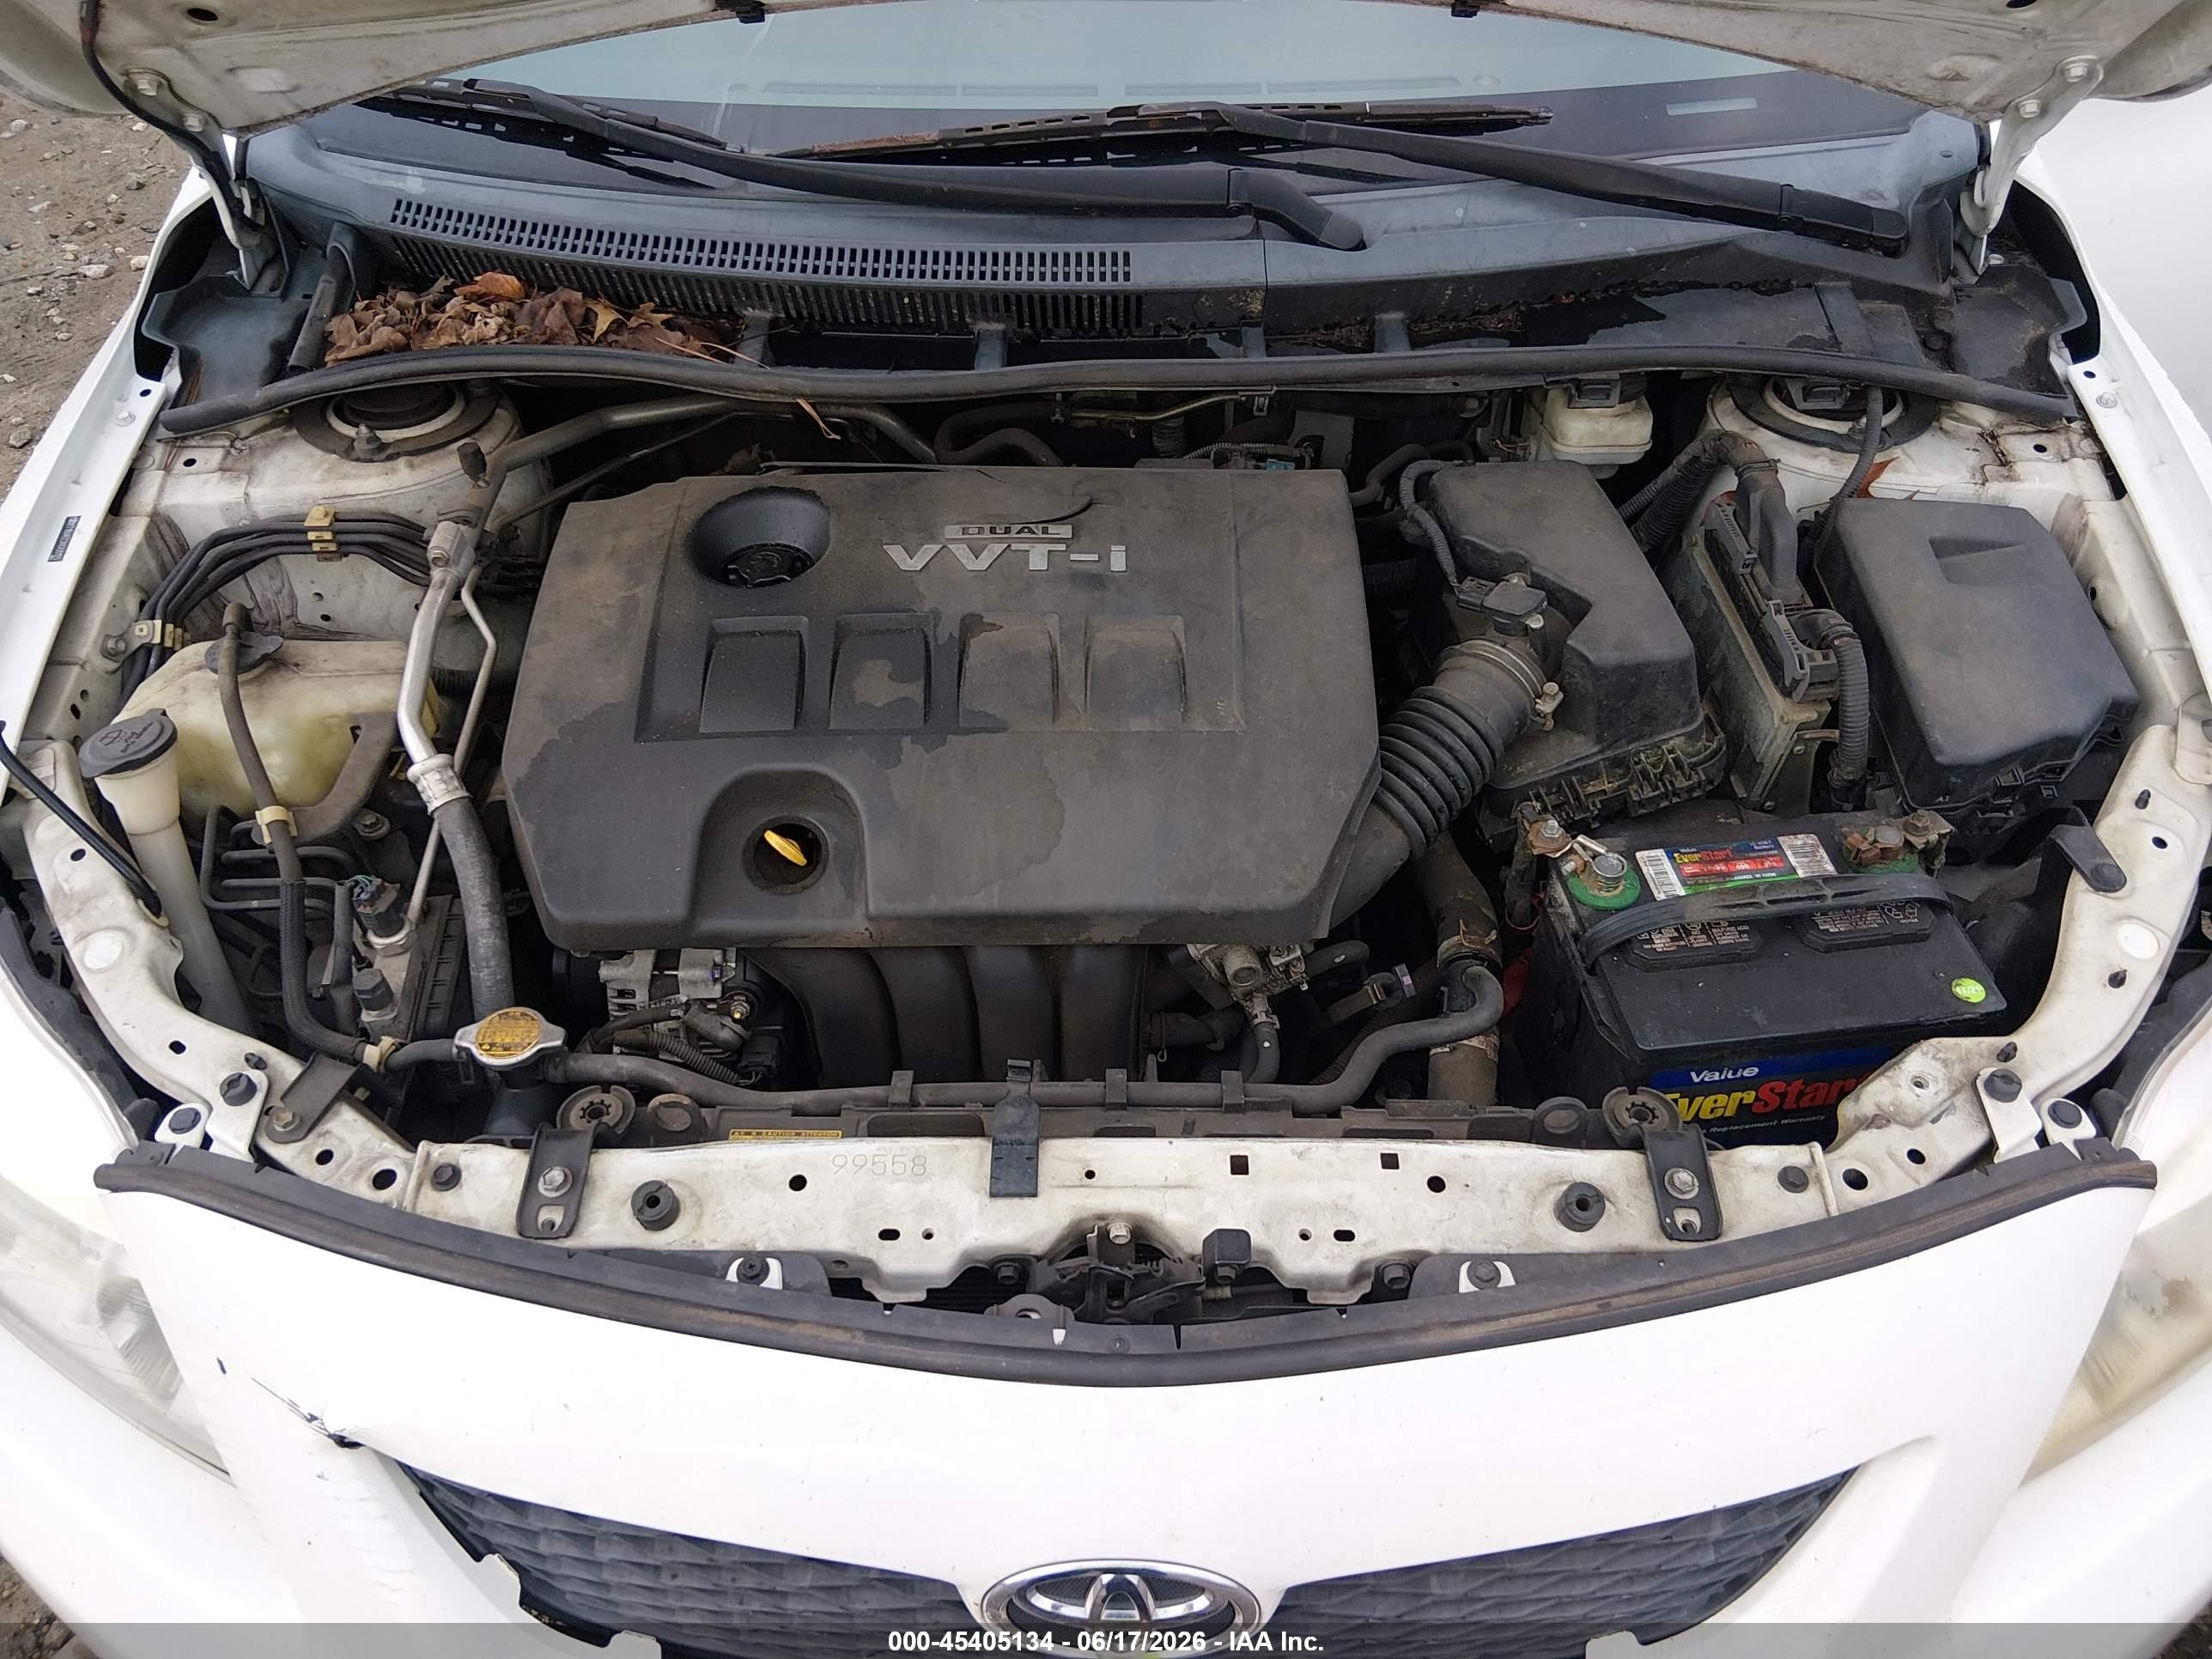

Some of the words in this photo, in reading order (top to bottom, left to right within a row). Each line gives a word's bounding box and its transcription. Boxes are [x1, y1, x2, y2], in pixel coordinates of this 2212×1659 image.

[960, 525, 1062, 536] DUAL
[882, 543, 1127, 572] VVT-i
[1675, 848, 1733, 863] EverStart
[1690, 1066, 1759, 1083] Value
[1710, 1120, 1778, 1133] Replacement
[1781, 1115, 1826, 1125] Warranty
[831, 1153, 927, 1176] 99558
